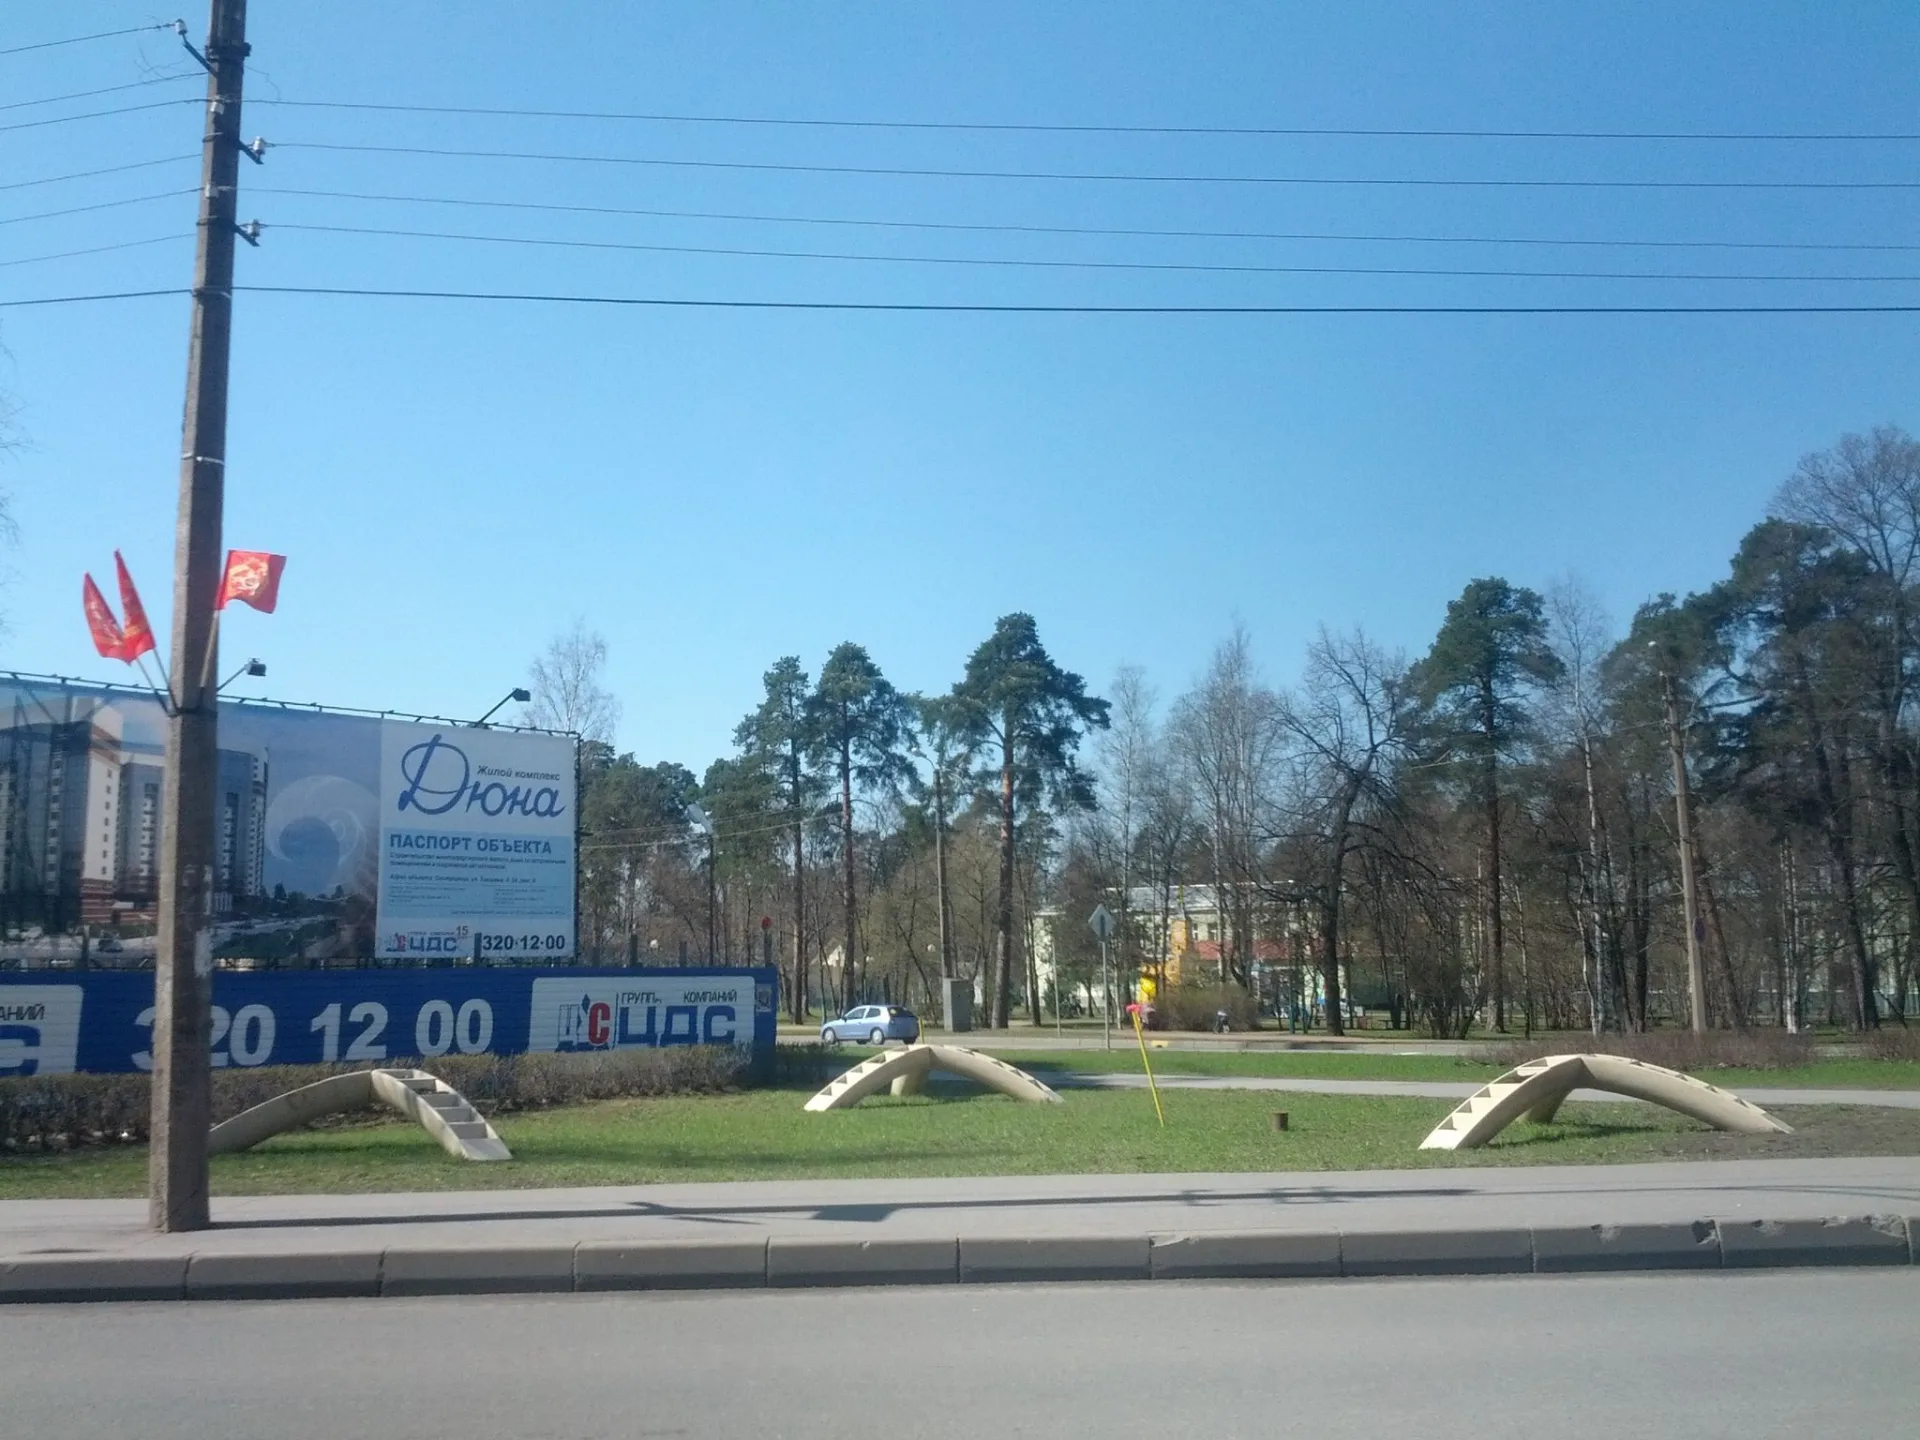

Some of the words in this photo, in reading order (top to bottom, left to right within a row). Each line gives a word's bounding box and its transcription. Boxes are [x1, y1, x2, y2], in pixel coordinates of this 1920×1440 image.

[398, 734, 567, 817] Дюна
[477, 765, 512, 778] Жилой
[515, 768, 560, 781] комплекс
[389, 833, 471, 851] ПАСПОРТ
[476, 838, 552, 854] ОБЪЕКТА
[621, 991, 662, 1004] ГРУПП
[683, 989, 738, 1004] КОМПАНИЙ
[310, 1001, 389, 1062] 12
[415, 998, 493, 1057] 00
[618, 1005, 736, 1048] ЦДС
